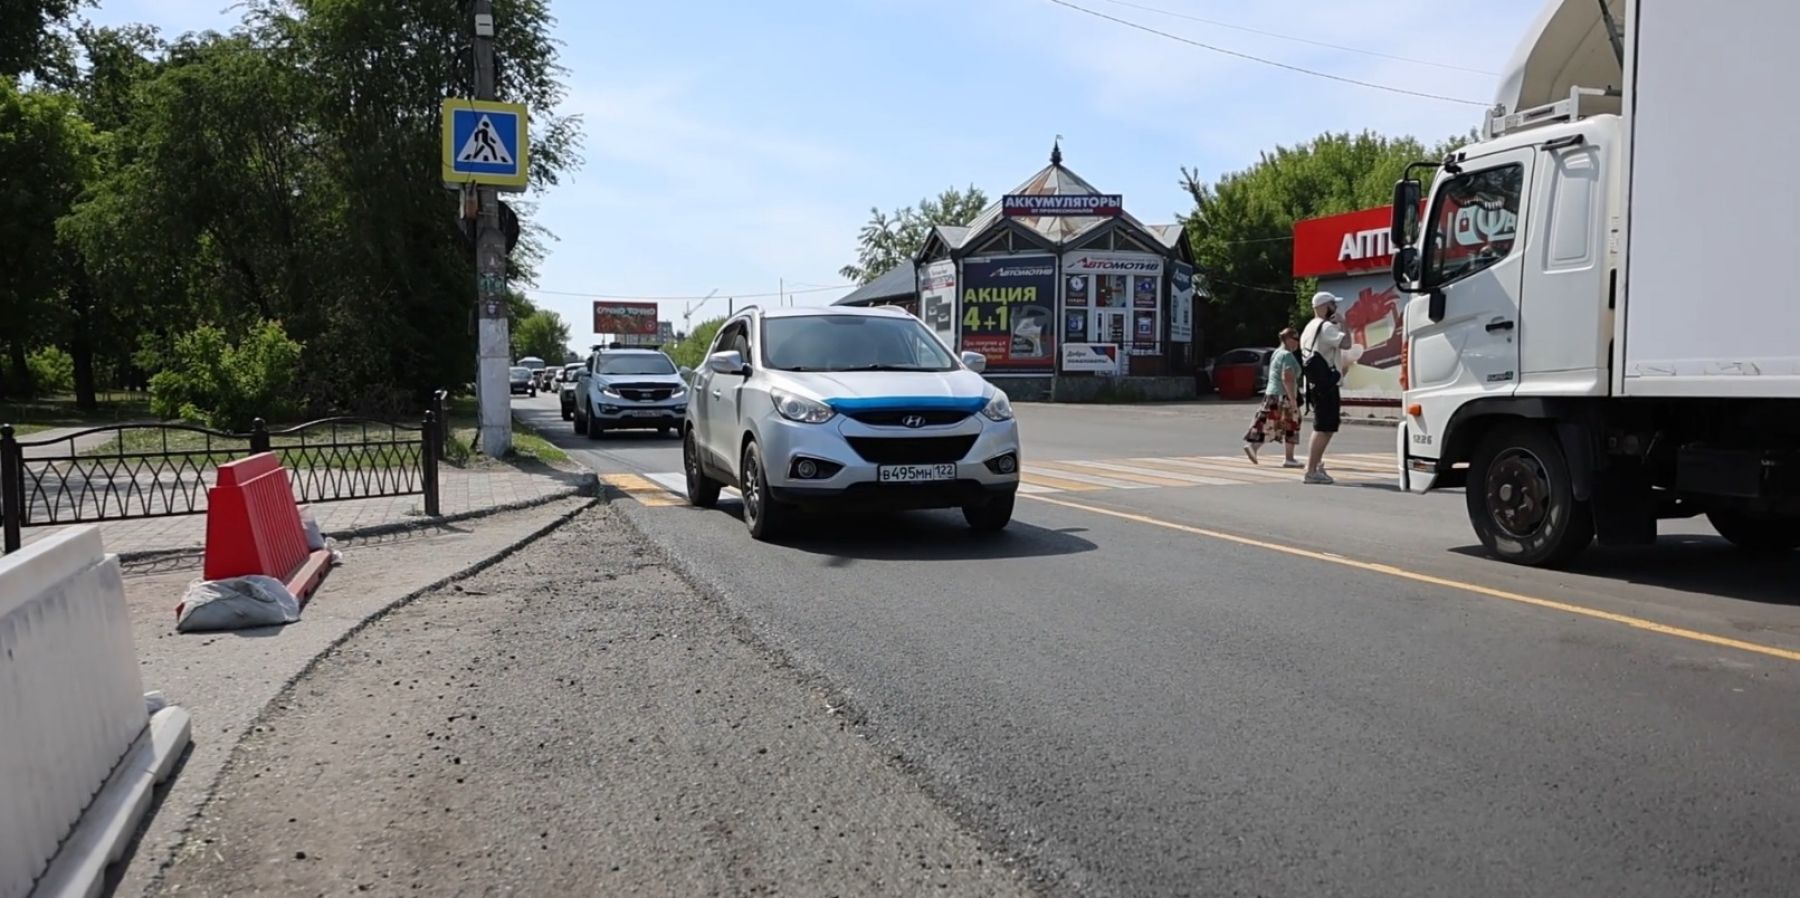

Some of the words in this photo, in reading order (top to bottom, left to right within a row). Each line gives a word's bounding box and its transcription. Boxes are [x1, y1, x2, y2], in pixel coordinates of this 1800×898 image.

[1005, 197, 1120, 208] АККУМУЛЯТОРЫ
[963, 286, 1037, 305] АКЦИЯ
[963, 306, 1008, 331] 4+1
[934, 465, 953, 475] 122
